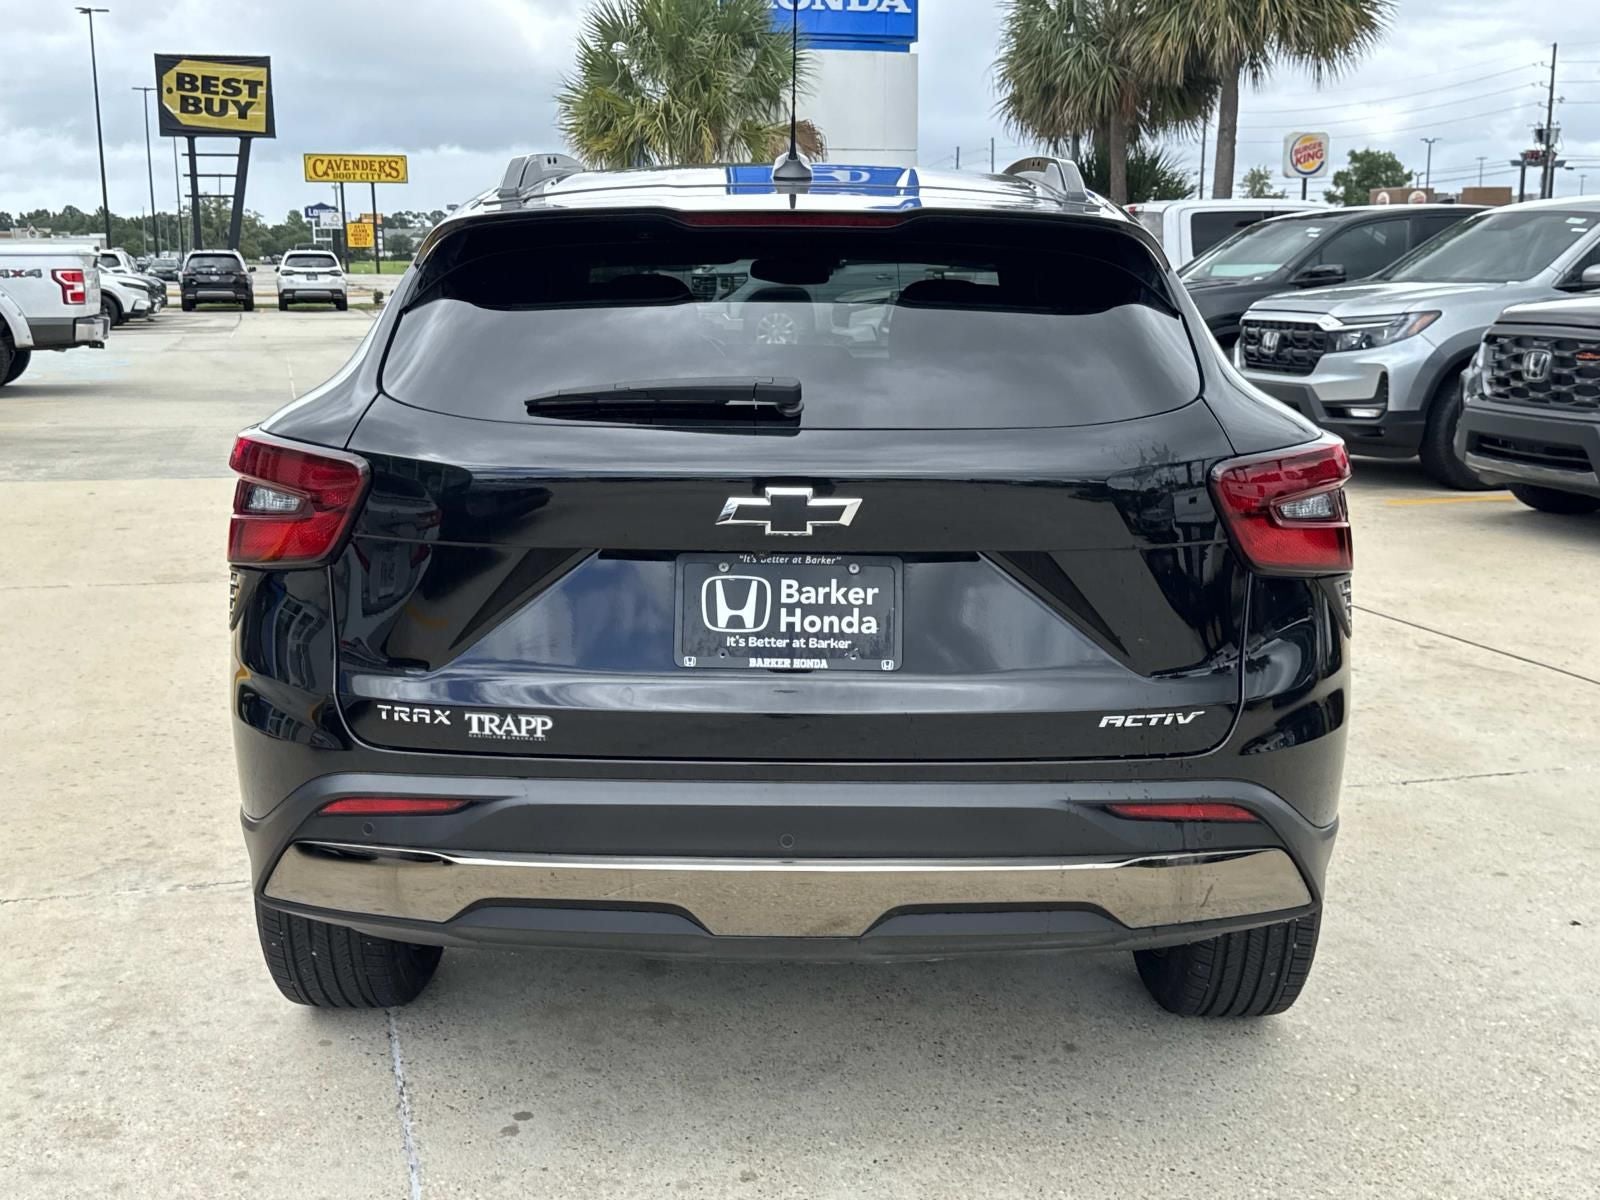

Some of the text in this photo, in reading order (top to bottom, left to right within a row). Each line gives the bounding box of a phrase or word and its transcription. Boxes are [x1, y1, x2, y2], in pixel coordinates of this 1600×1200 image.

[766, 0, 912, 13] ONDA
[176, 72, 264, 99] BEST
[180, 95, 256, 120] BUY
[1294, 141, 1323, 156] BURGER
[1295, 149, 1324, 166] KING
[312, 158, 400, 179] CAVENDER'S
[333, 172, 382, 180] BOOT CITY
[792, 556, 802, 564] at
[780, 578, 879, 605] Barker
[780, 607, 878, 634] Honda
[726, 635, 852, 649] It's Better at Barker
[749, 657, 829, 669] BARKER HONDA
[377, 704, 451, 725] TRAX
[1098, 711, 1205, 728] ACTIV
[464, 712, 553, 738] TRAPP
